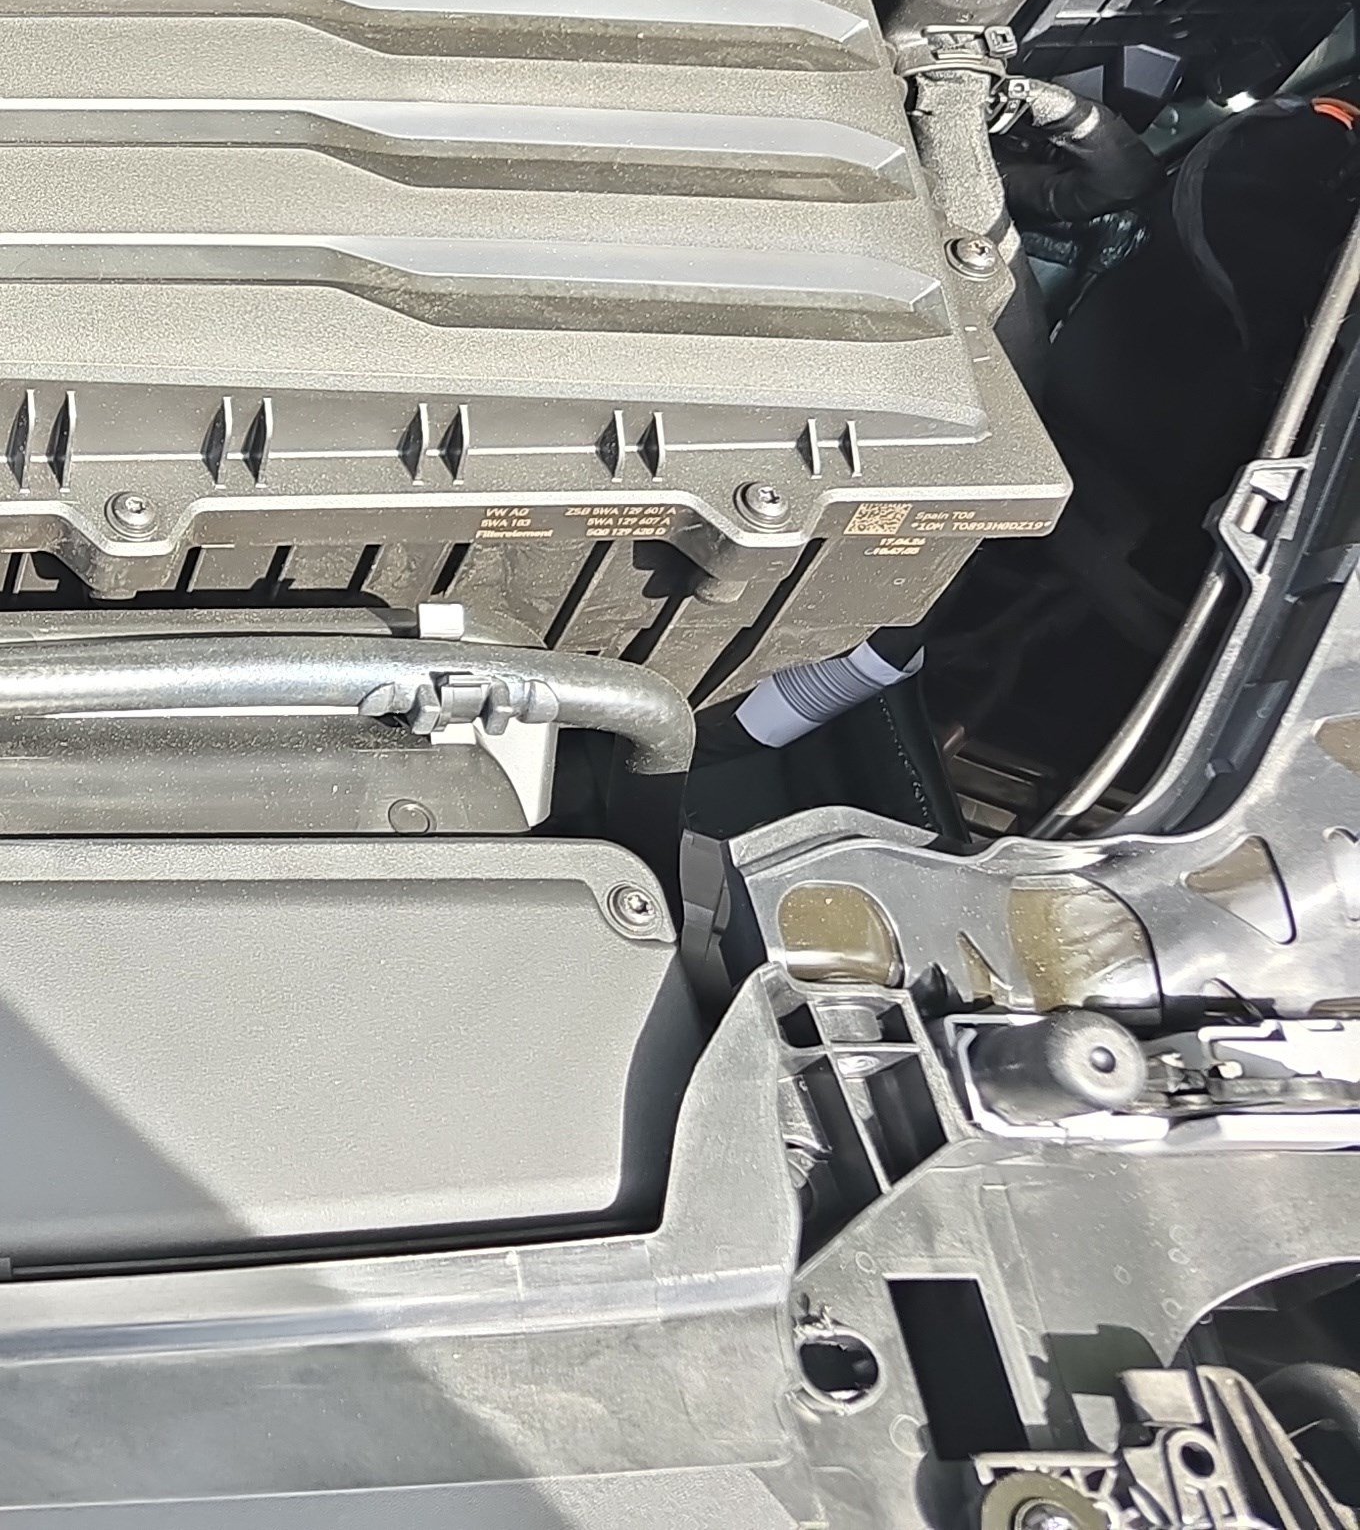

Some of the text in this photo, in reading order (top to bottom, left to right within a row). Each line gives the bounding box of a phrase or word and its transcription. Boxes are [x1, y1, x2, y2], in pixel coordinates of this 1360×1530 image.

[486, 507, 531, 517] VW AG
[621, 506, 643, 516] 129
[914, 511, 949, 521] Spain
[616, 517, 637, 527] 129
[611, 527, 631, 537] 129
